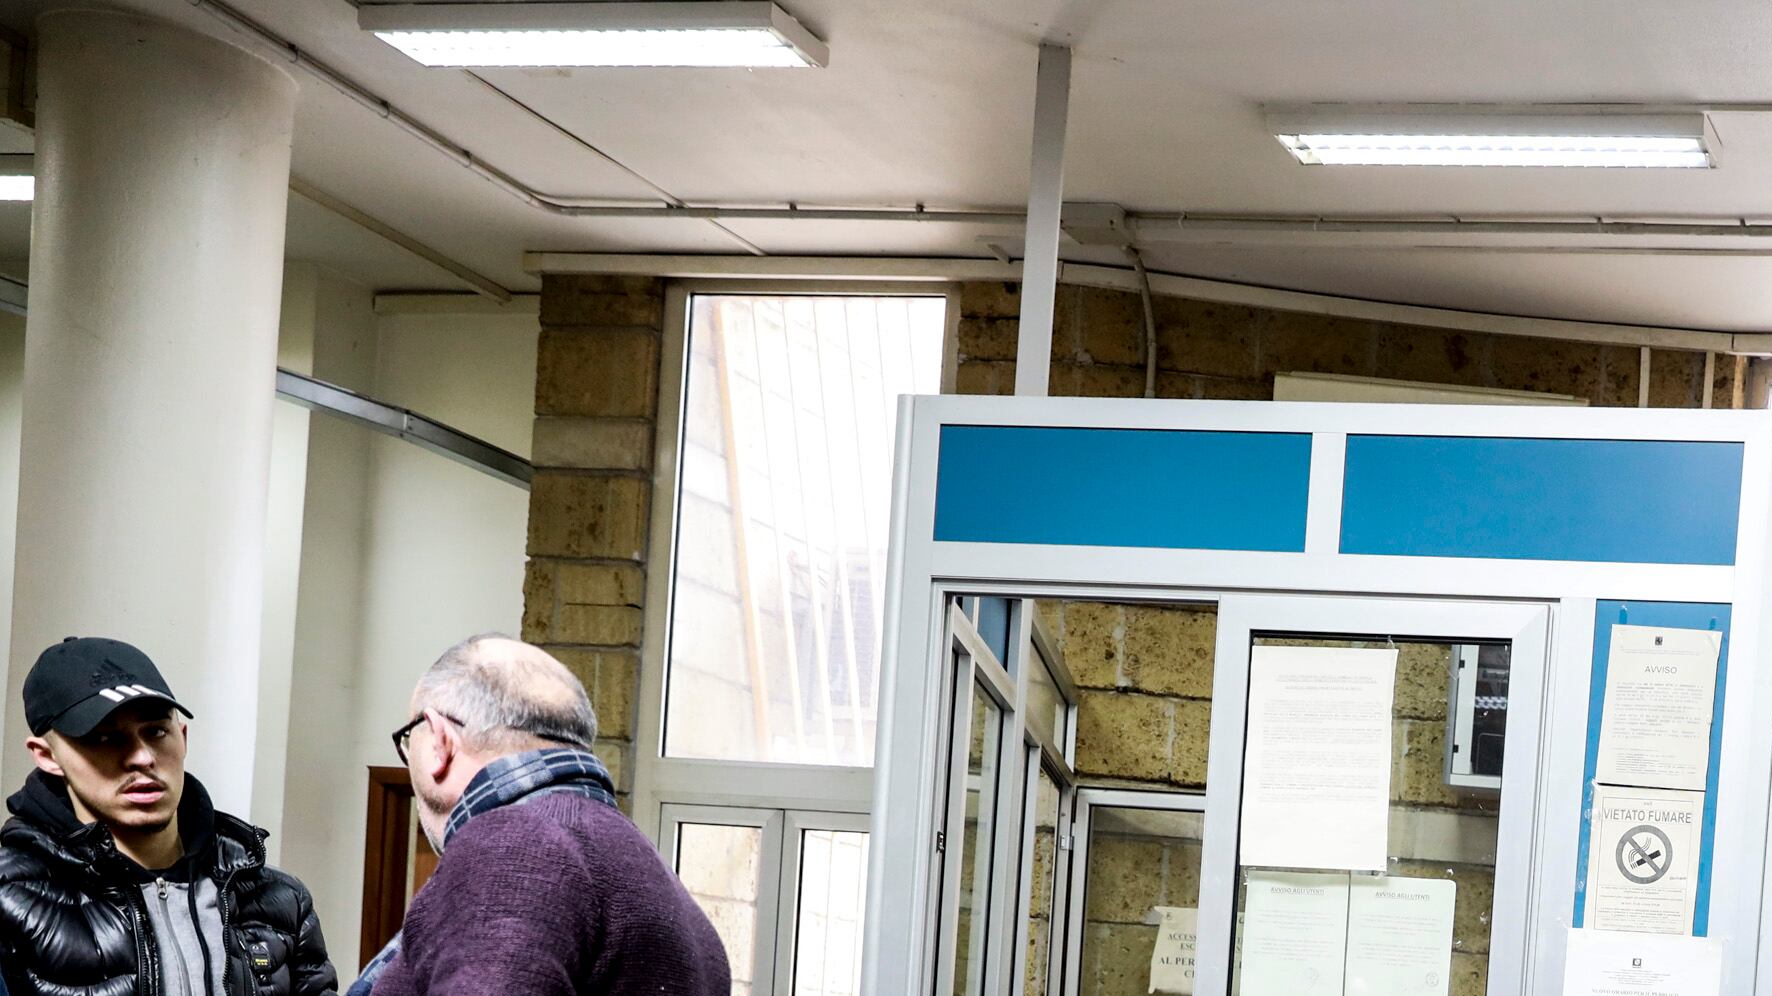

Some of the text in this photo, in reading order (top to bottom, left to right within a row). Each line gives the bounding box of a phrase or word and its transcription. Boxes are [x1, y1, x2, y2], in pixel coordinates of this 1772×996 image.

[1645, 665, 1678, 674] AVVISO
[1603, 808, 1692, 824] VIETATO FUMARE
[1175, 957, 1195, 966] PER
